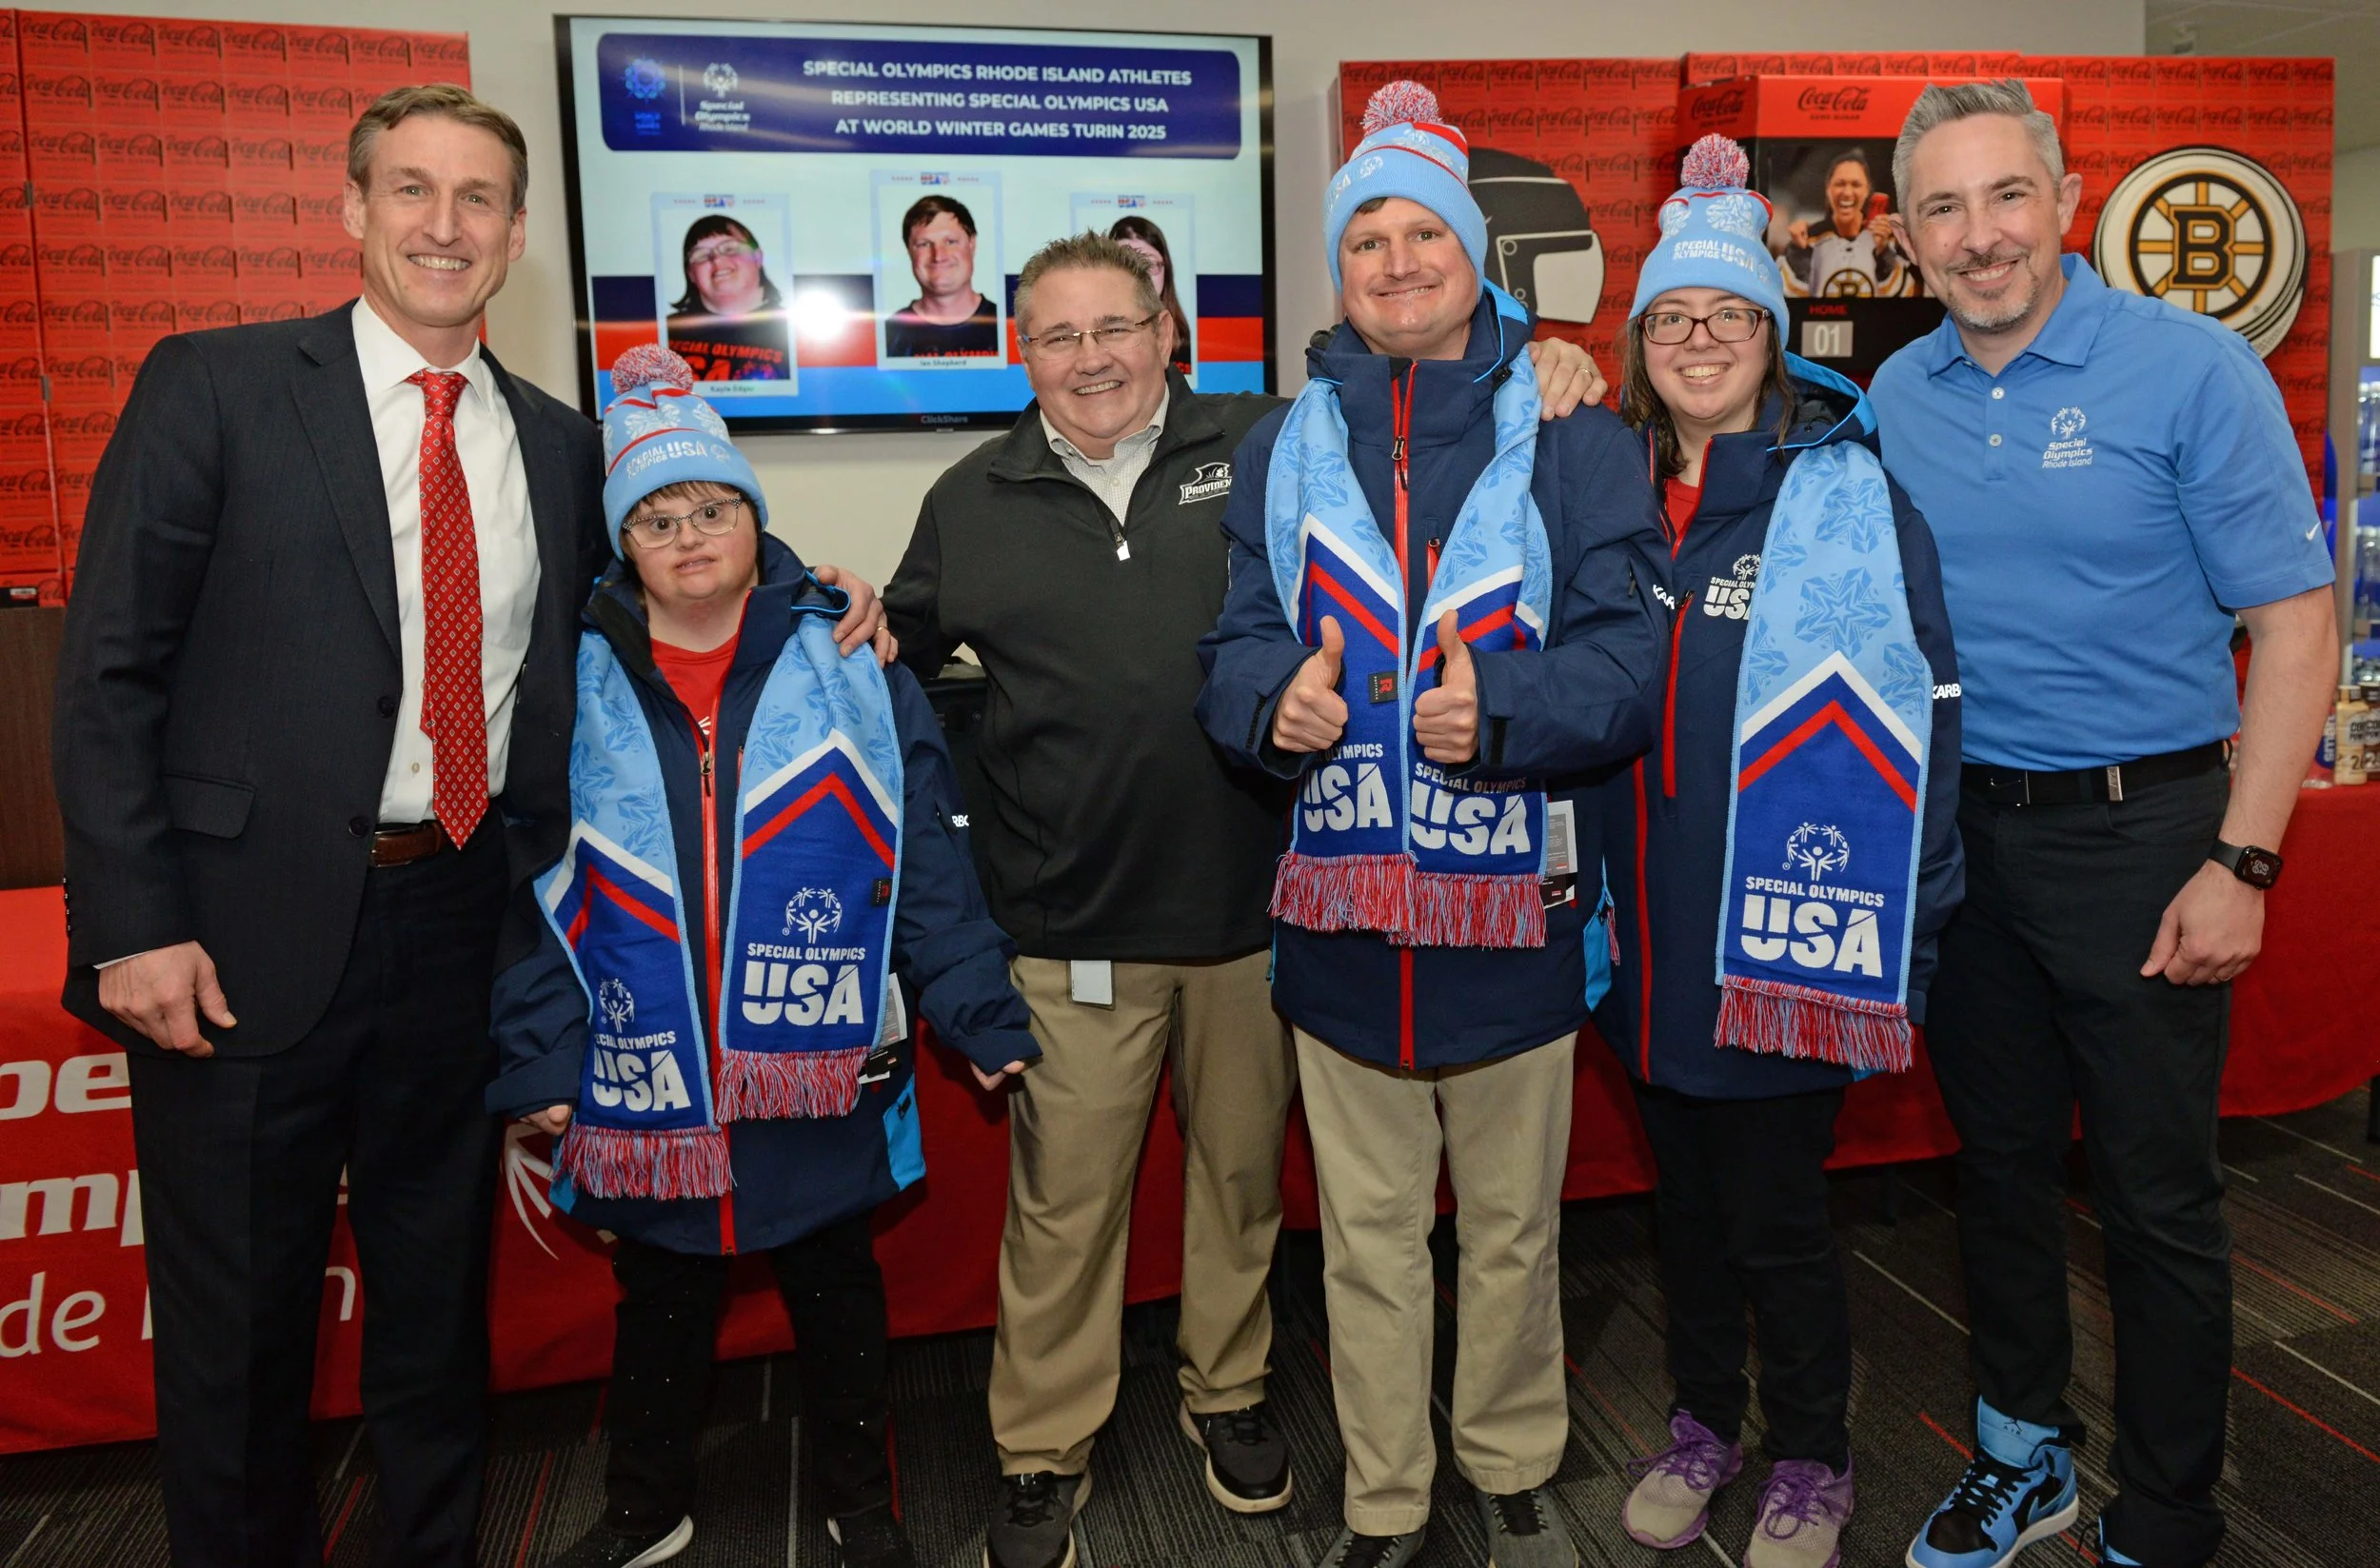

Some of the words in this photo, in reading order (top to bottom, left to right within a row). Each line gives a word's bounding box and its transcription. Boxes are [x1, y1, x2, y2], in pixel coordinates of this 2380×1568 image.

[803, 61, 879, 77] SPECIAL
[883, 63, 972, 79] OLYMPICS
[976, 65, 1038, 81] RHODE
[1042, 67, 1104, 83] ISLAND
[1108, 69, 1192, 86] ATHLETES
[831, 90, 964, 108] REPRESENTING
[969, 93, 1041, 109] SPECIAL
[1043, 95, 1131, 111] OLYMPICS
[1135, 97, 1169, 112] USA
[835, 119, 861, 134] AT
[863, 119, 932, 135] WORLD
[936, 121, 1005, 137] WINTER
[1008, 122, 1069, 138] GAMES
[1073, 124, 1124, 139] TURIN
[1127, 125, 1167, 140] 2025
[1675, 240, 1721, 251] SPECIAL
[1721, 242, 1755, 272] USA
[1810, 305, 1848, 315] HOME
[1814, 325, 1841, 355] 01
[711, 342, 783, 363] OLYMPICS
[666, 441, 708, 459] USA
[2043, 447, 2093, 462] Olympics
[2048, 438, 2087, 450] Special
[2042, 460, 2068, 468] Rhode
[2069, 456, 2093, 466] Island
[1710, 577, 1738, 588] SPECIAL
[1473, 777, 1527, 794] OLYMPICS
[1303, 763, 1394, 832] USA
[1411, 780, 1532, 855] USA
[1746, 876, 1805, 896] SPECIAL
[1809, 884, 1885, 907] OLYMPICS
[1741, 894, 1883, 978] USA
[747, 943, 803, 960] SPECIAL
[804, 946, 866, 962] OLYMPICS
[742, 961, 864, 1026] USA
[619, 1031, 677, 1050] OLYMPICS
[592, 1043, 692, 1112] USA
